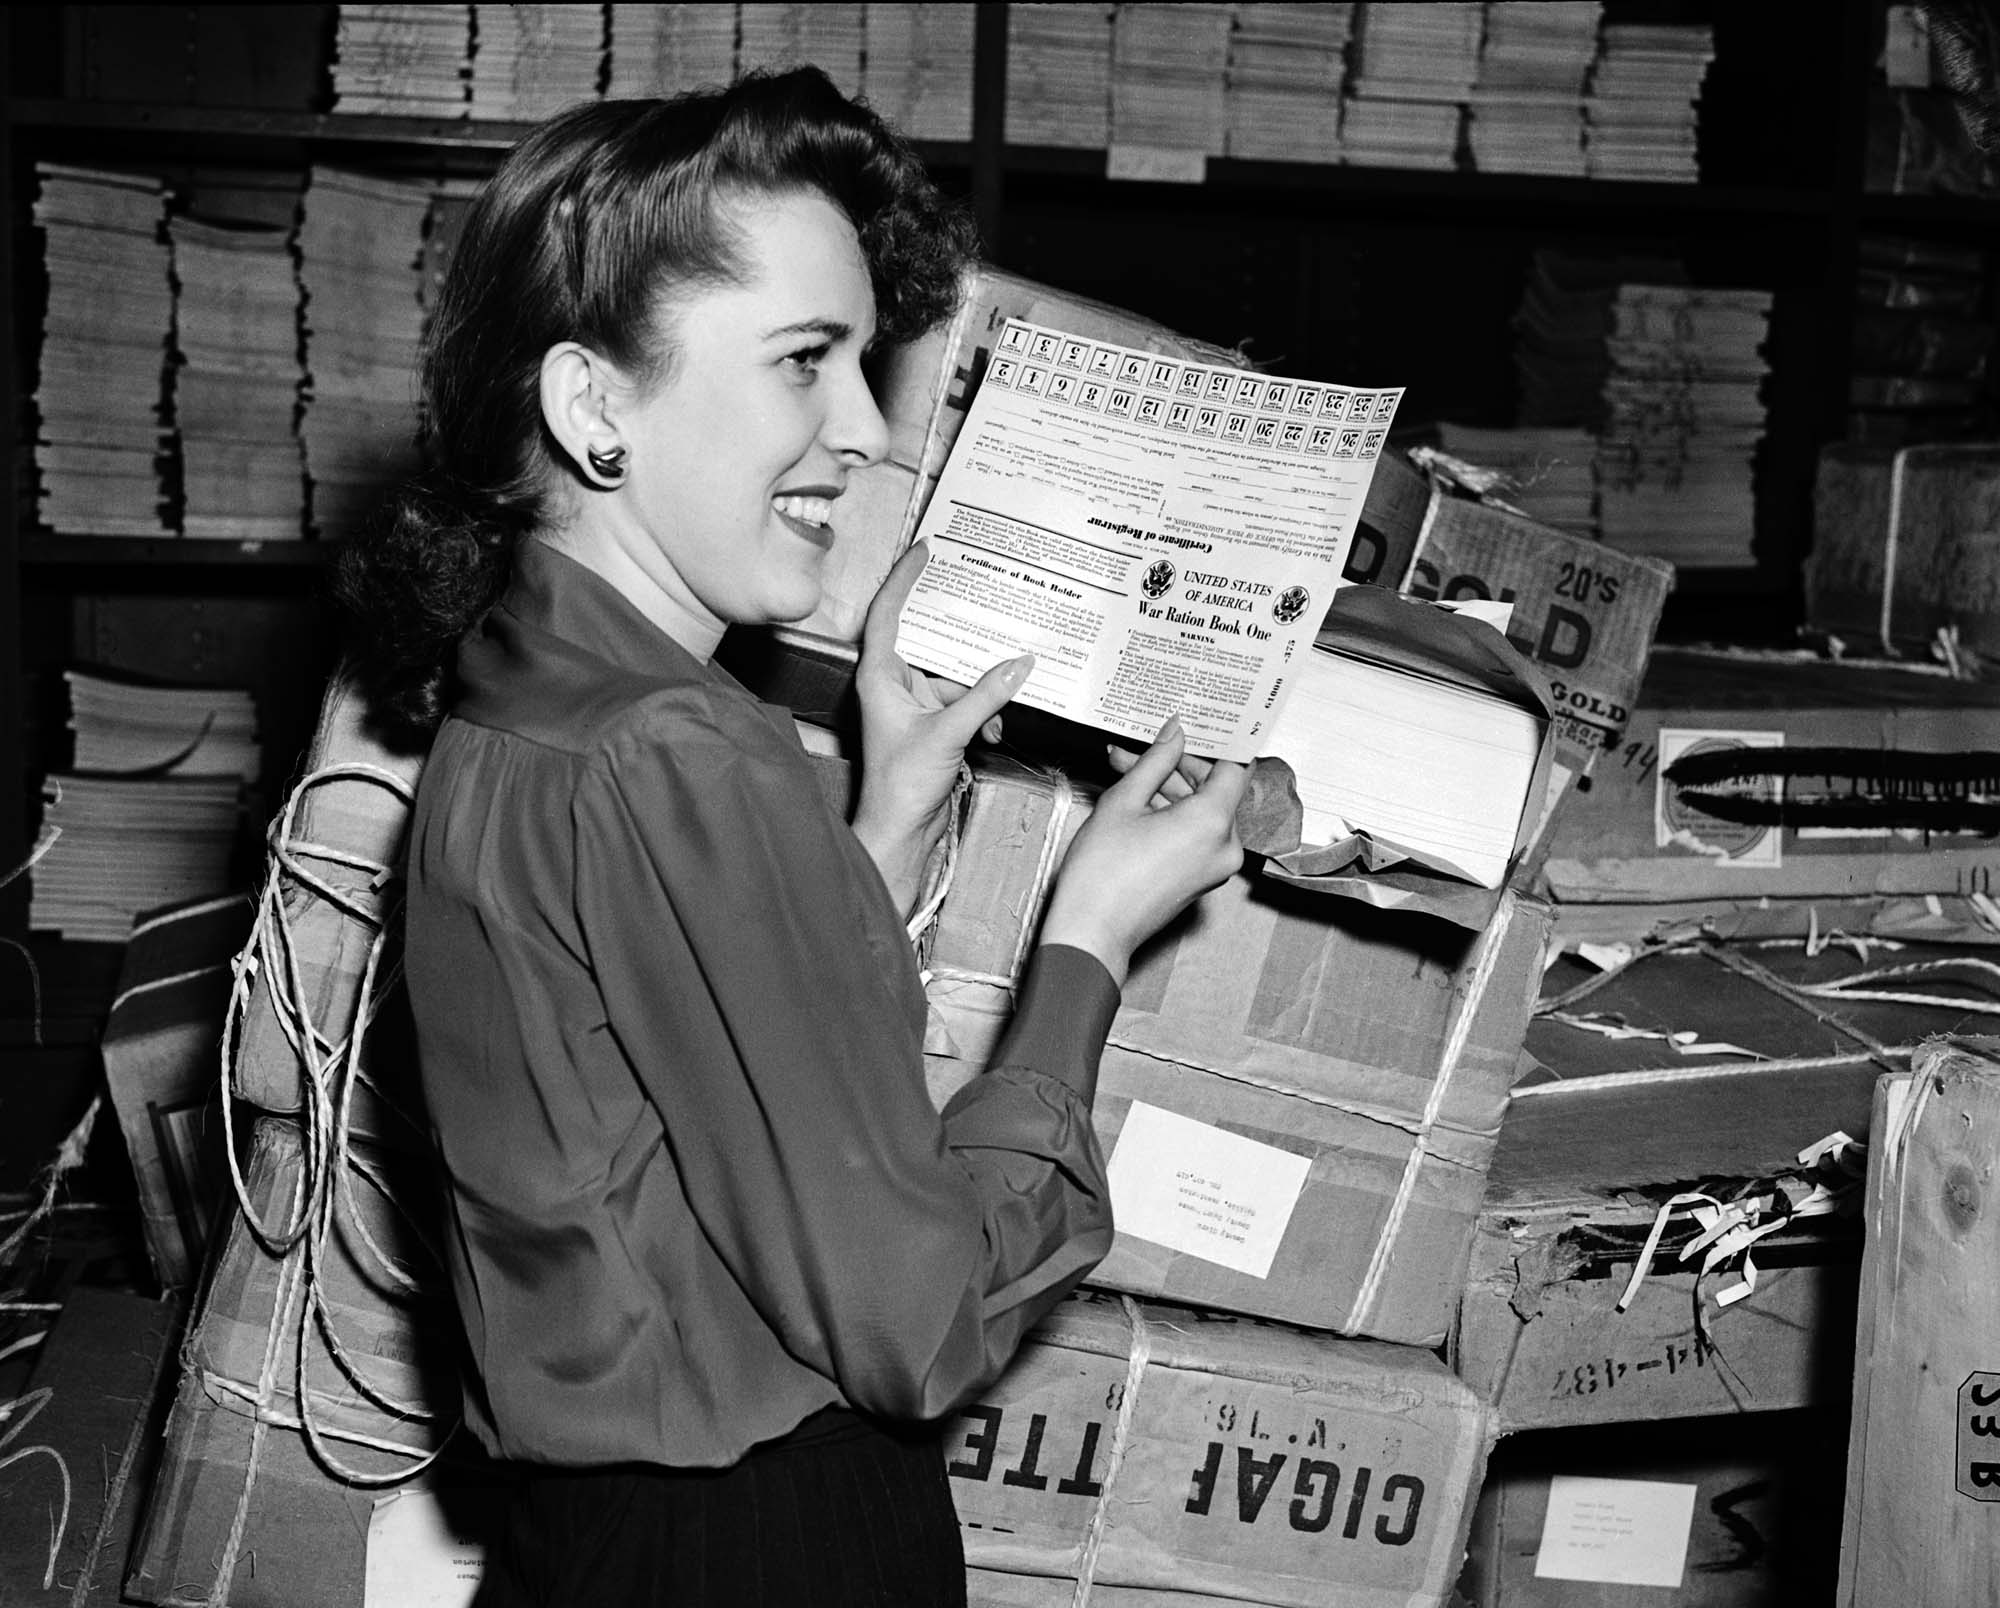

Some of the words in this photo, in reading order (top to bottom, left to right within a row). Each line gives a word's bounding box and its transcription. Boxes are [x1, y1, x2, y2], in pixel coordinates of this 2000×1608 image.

[1010, 330, 1021, 344] 1
[1038, 338, 1051, 352] 3
[1068, 345, 1081, 360] 5
[1097, 352, 1108, 368] 7
[997, 362, 1010, 377] 2
[1127, 360, 1138, 375] 9
[1154, 365, 1172, 382] 11
[1028, 370, 1037, 385] 4
[1057, 378, 1068, 392] 6
[1182, 371, 1201, 388] 13
[1210, 375, 1229, 392] 15
[1085, 386, 1098, 401] 8
[1238, 380, 1258, 398] 17
[1267, 386, 1286, 402] 19
[1112, 392, 1131, 409] 10
[1296, 389, 1316, 407] 21
[1324, 393, 1345, 410] 23
[1352, 396, 1373, 413] 25
[1141, 399, 1160, 416] 12
[1171, 405, 1190, 422] 14
[1200, 410, 1217, 427] 16
[1227, 416, 1247, 433] 18
[1255, 421, 1275, 437] 20
[1283, 424, 1304, 441] 22
[1311, 428, 1332, 446] 24
[1341, 432, 1359, 448] 26
[1364, 432, 1382, 449] 28
[1086, 516, 1143, 539] Registrar
[1142, 530, 1157, 541] of
[1157, 534, 1213, 554] Certificate
[960, 553, 1007, 573] Certificate
[1009, 570, 1020, 579] of
[1022, 573, 1046, 588] Book
[1049, 582, 1082, 599] Holder
[1183, 569, 1229, 588] UNITED
[1229, 578, 1273, 596] STATES
[1554, 561, 1620, 604] 20'S
[1184, 588, 1203, 602] OF
[1201, 592, 1253, 612] AMERICA
[1138, 599, 1164, 619] War
[1164, 605, 1205, 627] Ration
[1208, 614, 1240, 635] Book
[1245, 623, 1272, 640] One
[1179, 630, 1215, 644] WARNING
[1550, 680, 1627, 723] GOLD
[1102, 714, 1126, 728] OFFICE
[1129, 723, 1140, 731] OF
[1142, 726, 1161, 738] PRIC
